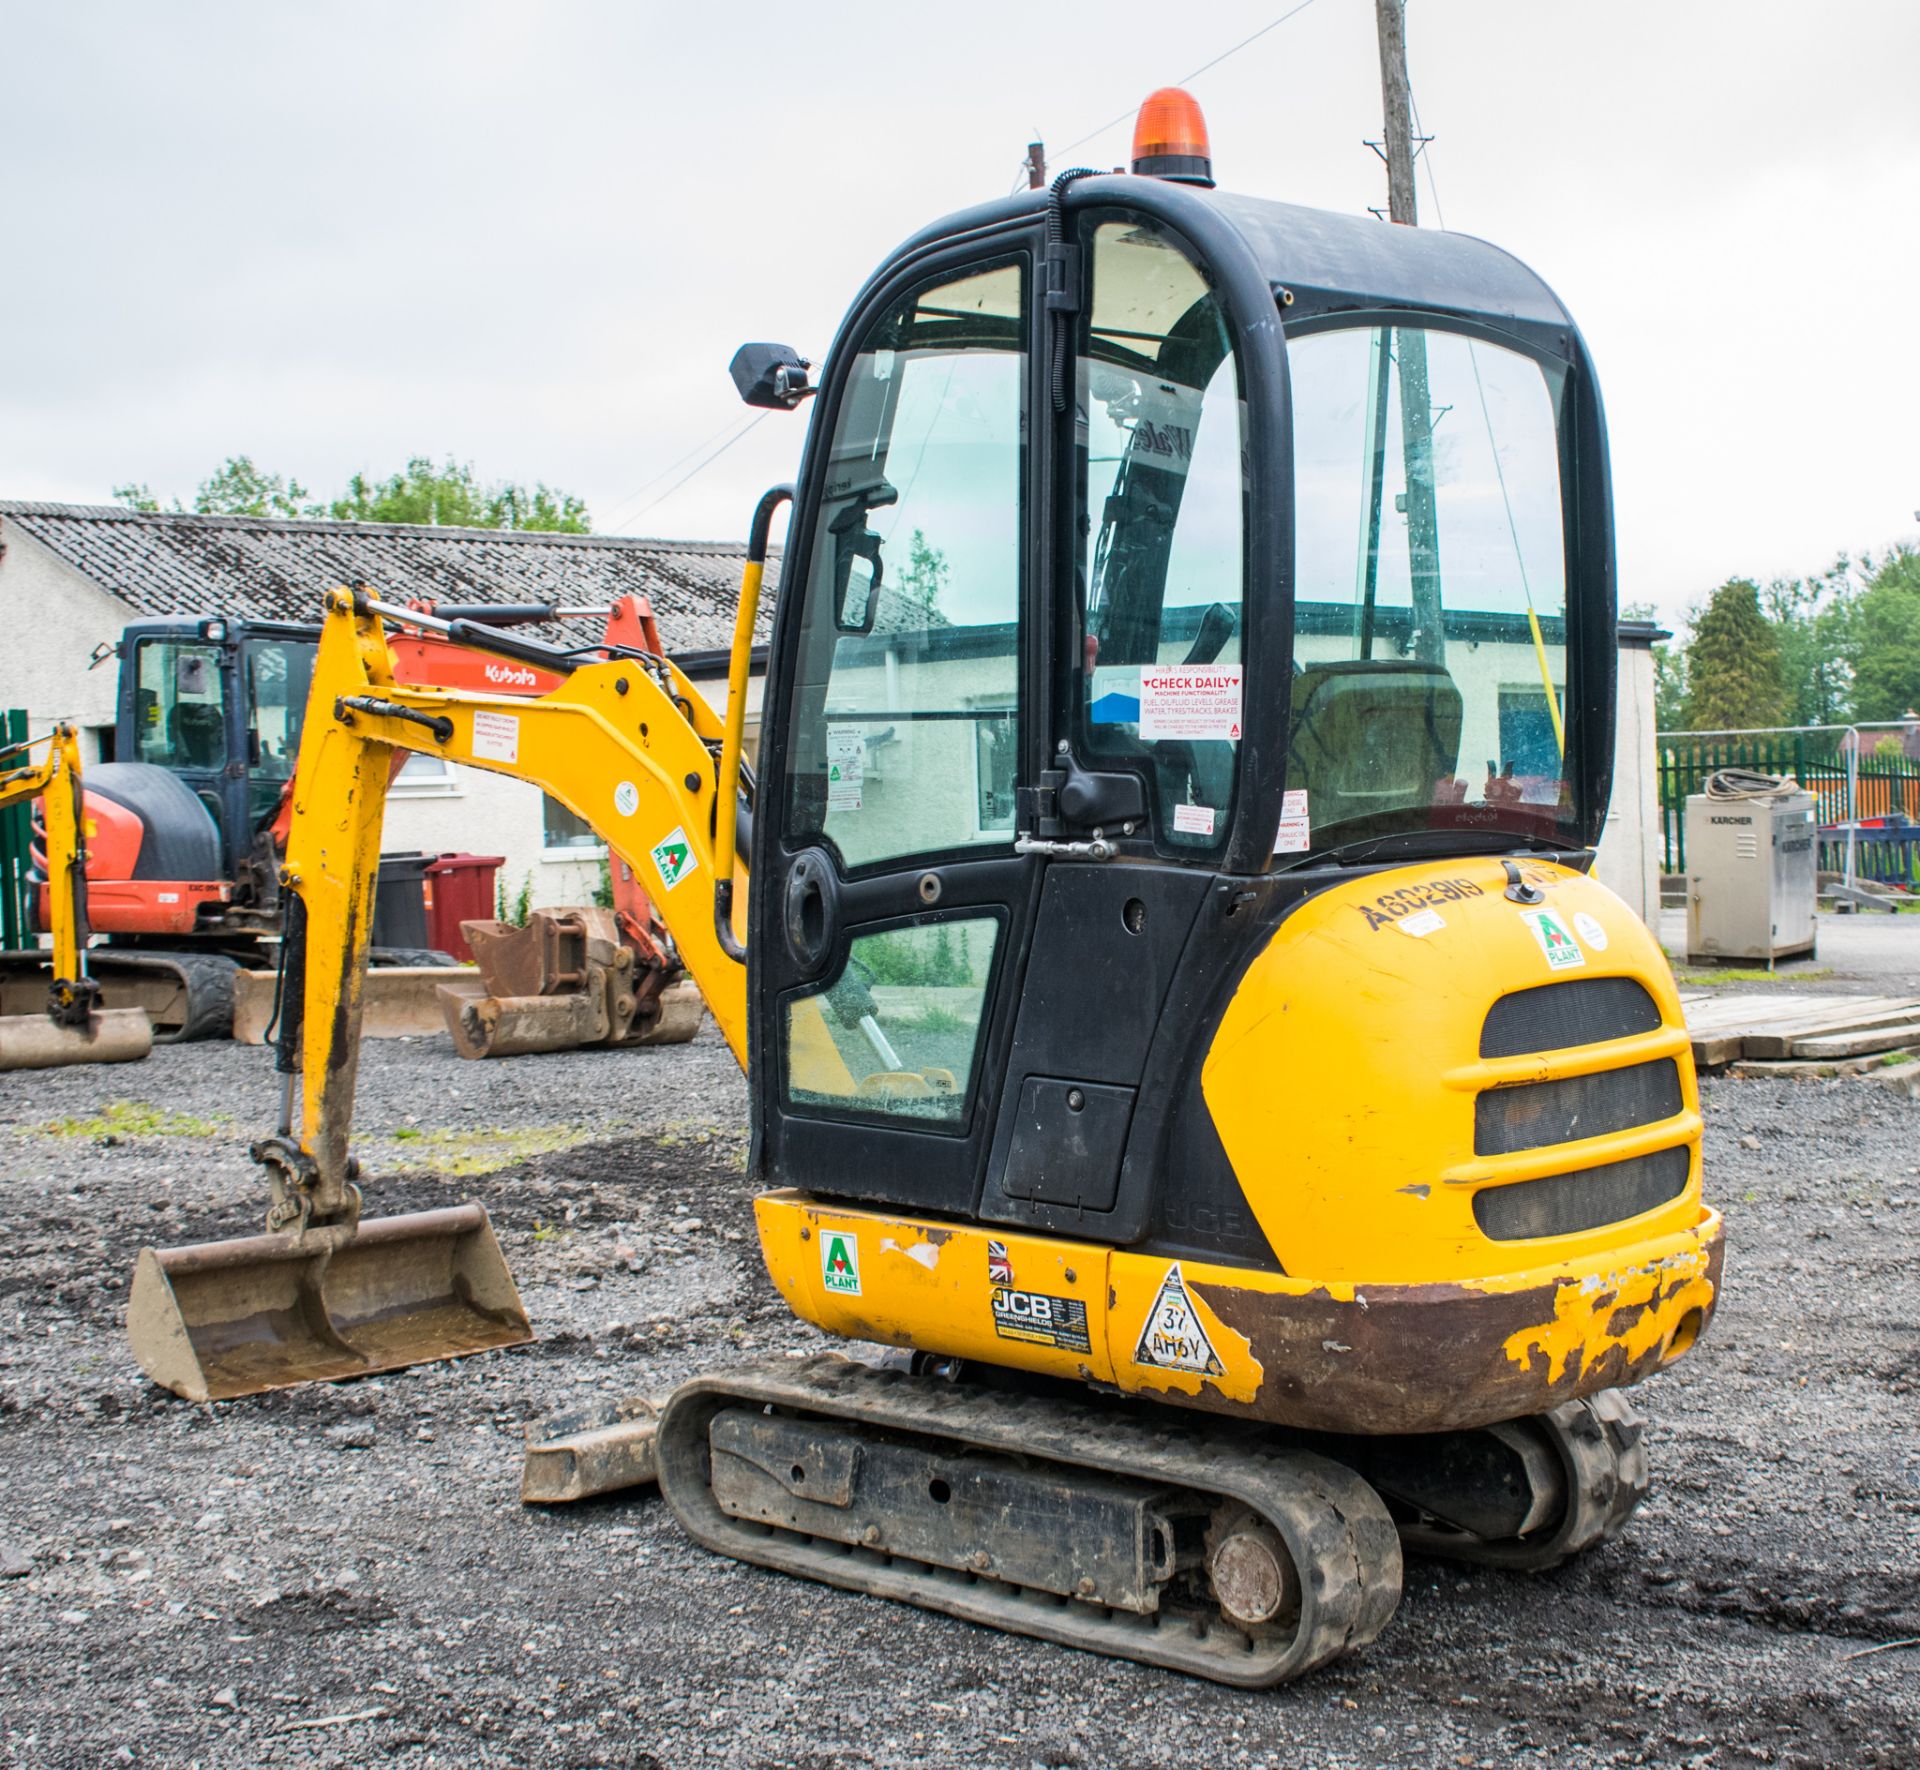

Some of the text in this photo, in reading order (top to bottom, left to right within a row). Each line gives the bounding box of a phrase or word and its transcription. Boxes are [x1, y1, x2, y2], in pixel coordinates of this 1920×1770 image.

[485, 664, 537, 686] Kubota
[1180, 665, 1226, 674] RESPONSIBILITY
[1151, 677, 1231, 689] CHECK DAILY
[1215, 698, 1238, 706] GREASE
[1215, 707, 1238, 715] BRAKES
[653, 847, 676, 885] PLANT
[662, 842, 688, 878] A
[1536, 914, 1573, 949] A
[1548, 948, 1582, 963] PLANT
[827, 1237, 855, 1275] A
[825, 1275, 858, 1290] PLANT
[993, 1290, 1052, 1319] JCB
[995, 1311, 1052, 1328] GREENSHIELDS
[1163, 1308, 1186, 1331] 37
